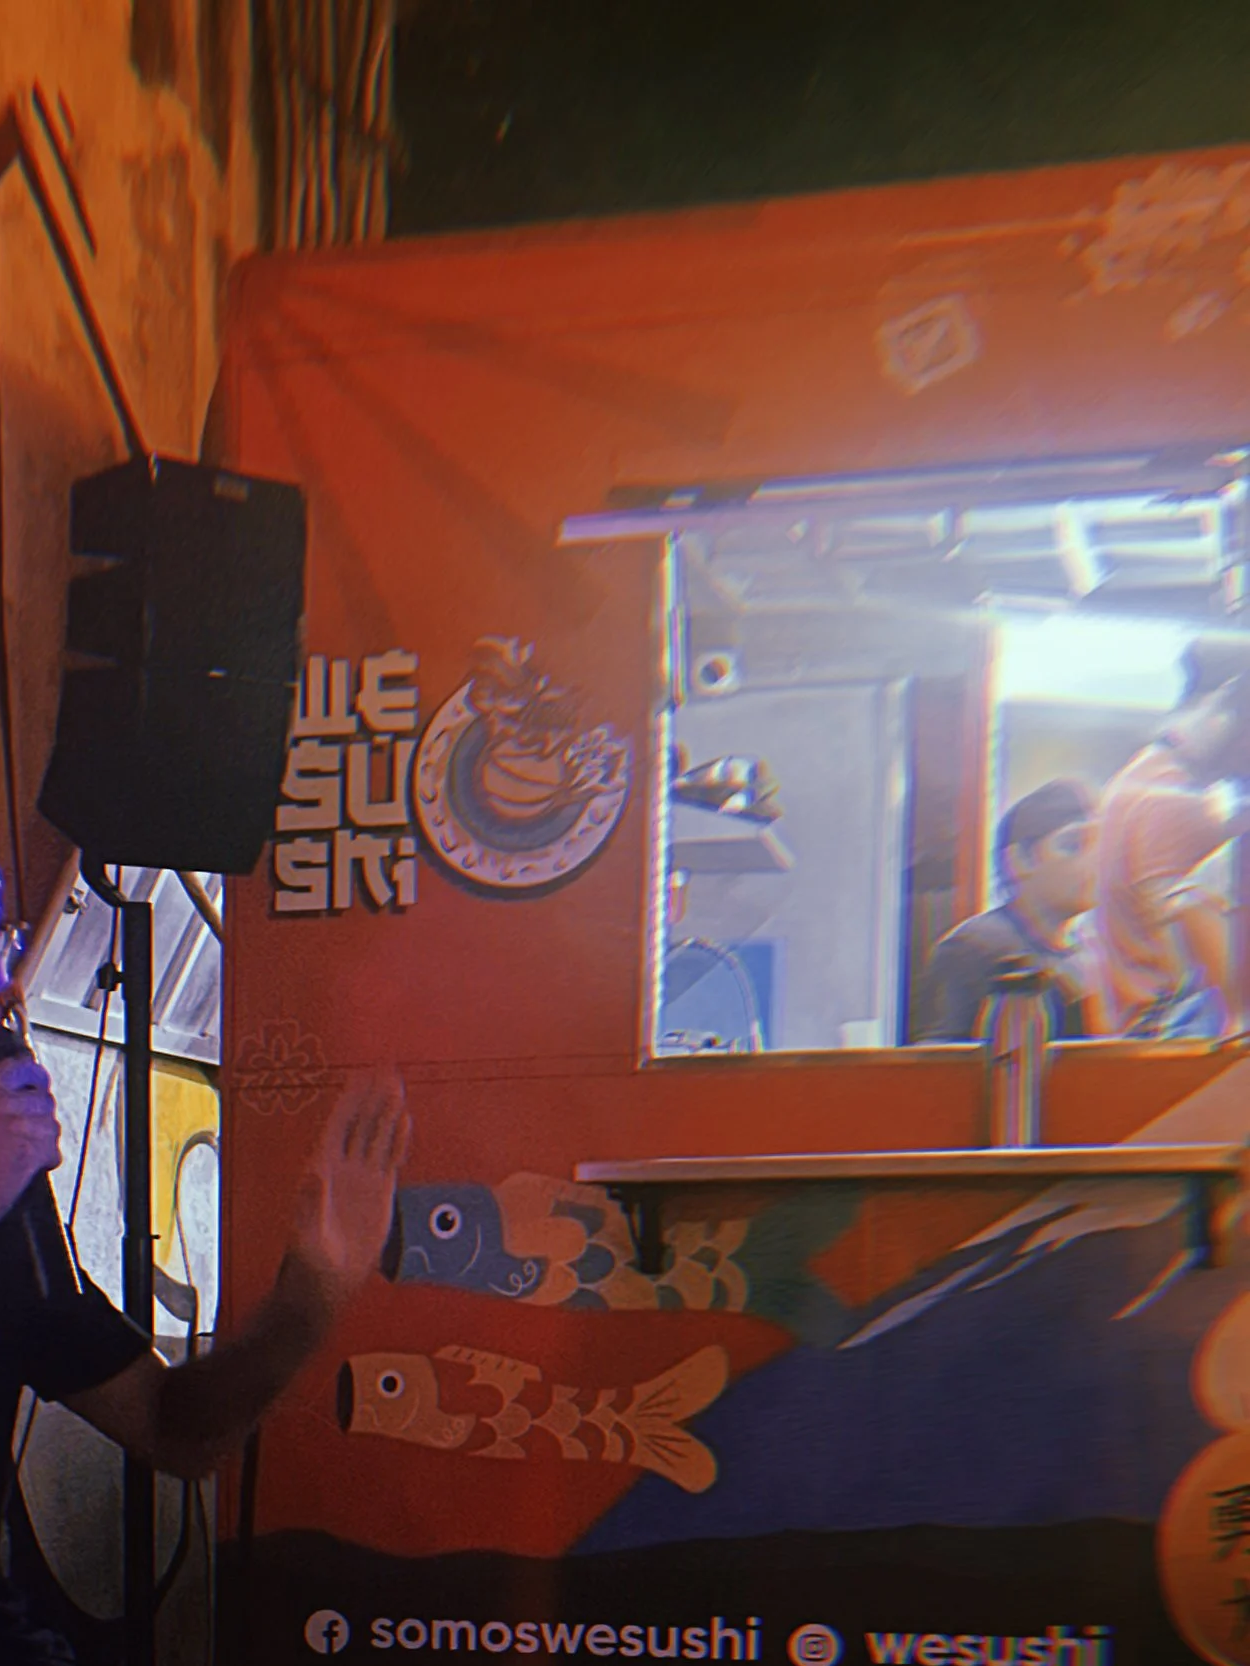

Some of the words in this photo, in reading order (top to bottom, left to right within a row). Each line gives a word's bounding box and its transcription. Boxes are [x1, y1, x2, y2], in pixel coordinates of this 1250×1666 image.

[295, 649, 418, 735] WE
[276, 735, 418, 830] SU
[370, 1615, 762, 1660] somoswesushi
